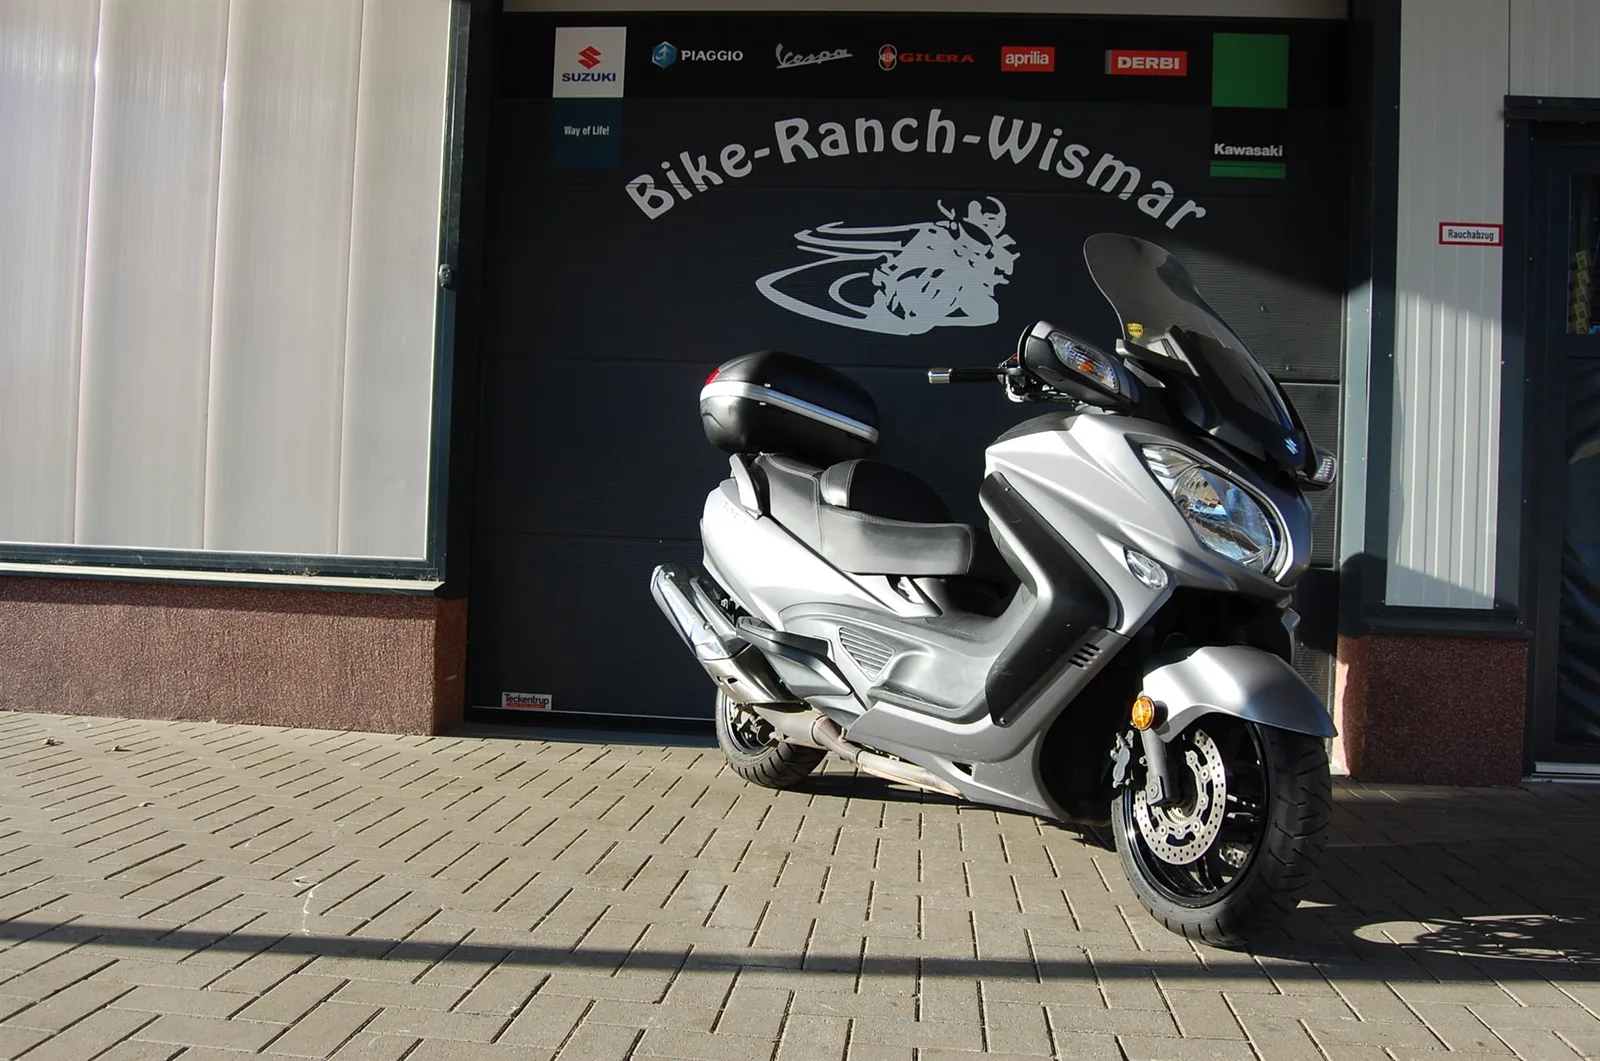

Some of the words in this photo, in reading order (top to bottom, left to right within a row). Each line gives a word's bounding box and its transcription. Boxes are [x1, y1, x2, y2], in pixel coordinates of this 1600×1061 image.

[681, 50, 744, 62] PIAGGIO
[776, 43, 853, 69] Vespa
[899, 53, 975, 63] GILERA
[1005, 51, 1049, 66] aprilia
[1117, 56, 1180, 70] DERBI
[562, 72, 616, 82] SUZUKI
[564, 125, 580, 137] Way
[582, 125, 591, 135] of
[593, 125, 609, 135] Life!
[1214, 143, 1283, 157] Kawasaki
[625, 109, 1206, 230] Bike-Ranch-Wismar
[1448, 229, 1494, 242] Rauchabzug
[504, 694, 550, 705] Teckentrup
